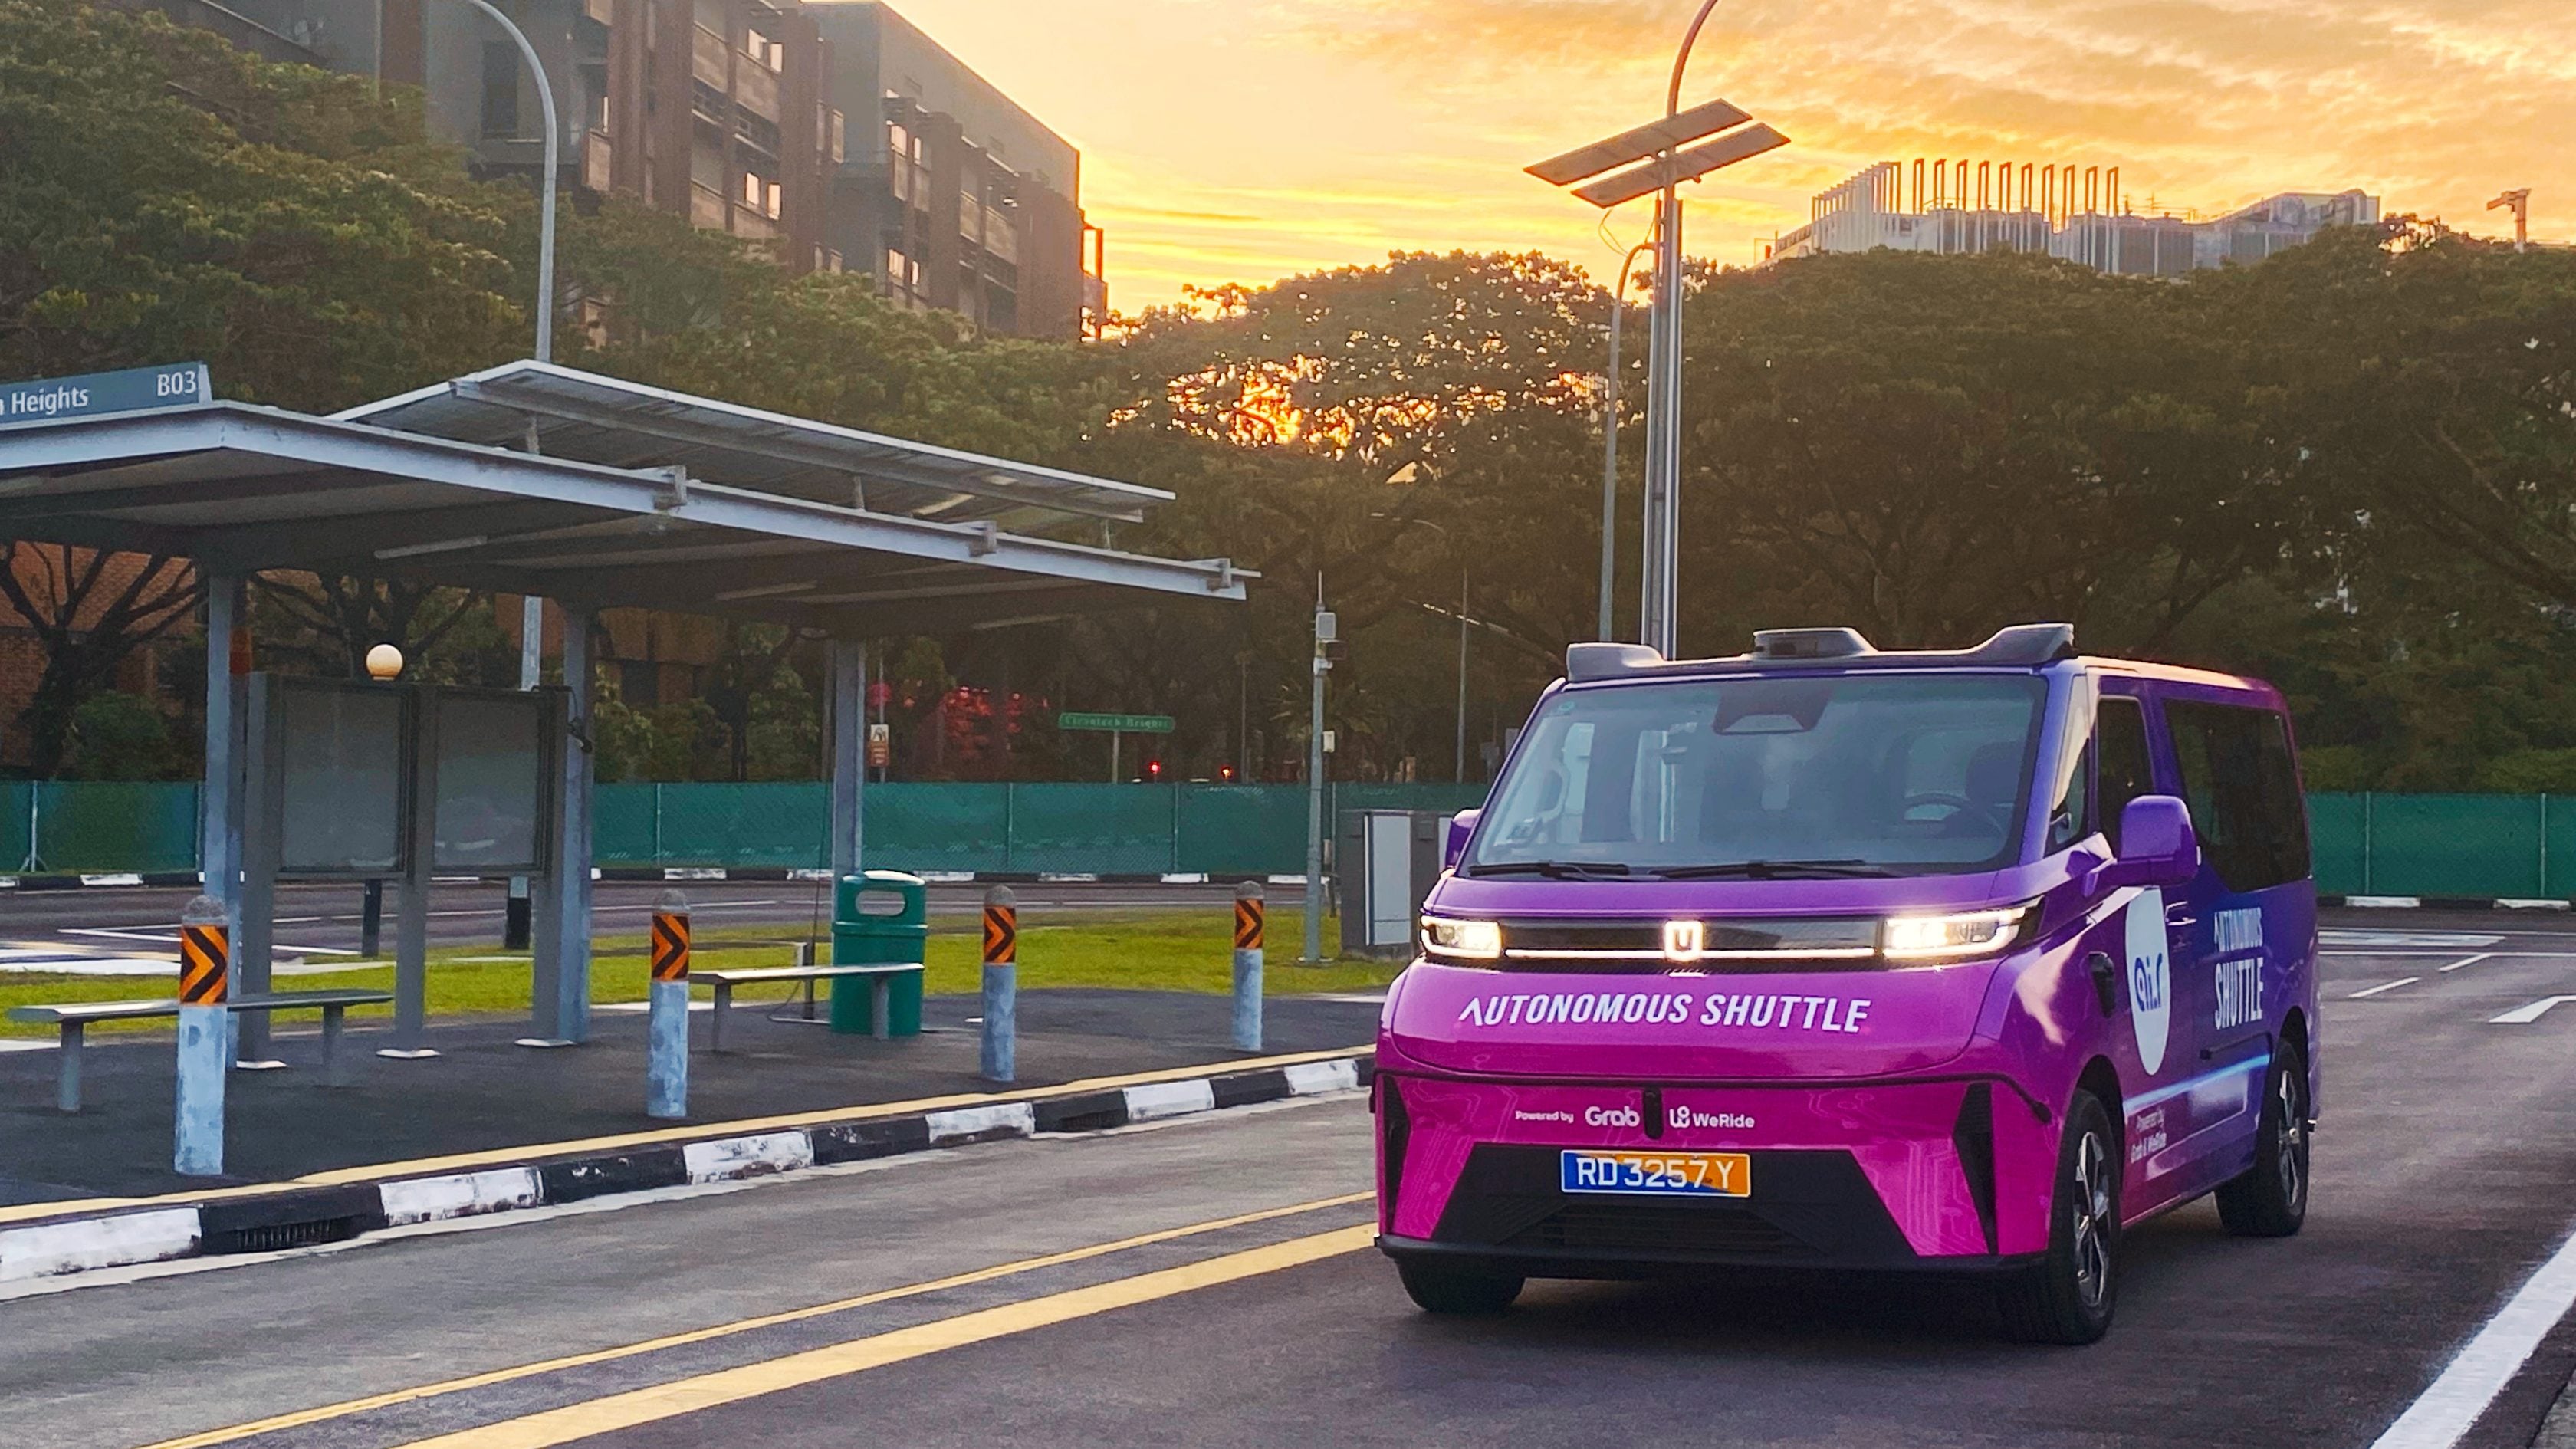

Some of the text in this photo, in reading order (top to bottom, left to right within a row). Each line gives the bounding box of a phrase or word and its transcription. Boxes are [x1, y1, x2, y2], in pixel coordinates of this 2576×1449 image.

[12, 385, 90, 415] Heights
[157, 371, 197, 396] B03
[1459, 993, 1871, 1033] AUTONOMOUS SHUTTLE
[2214, 957, 2264, 1030] SHUTTLE
[1515, 1106, 1756, 1128] Powered by Grab WeRide
